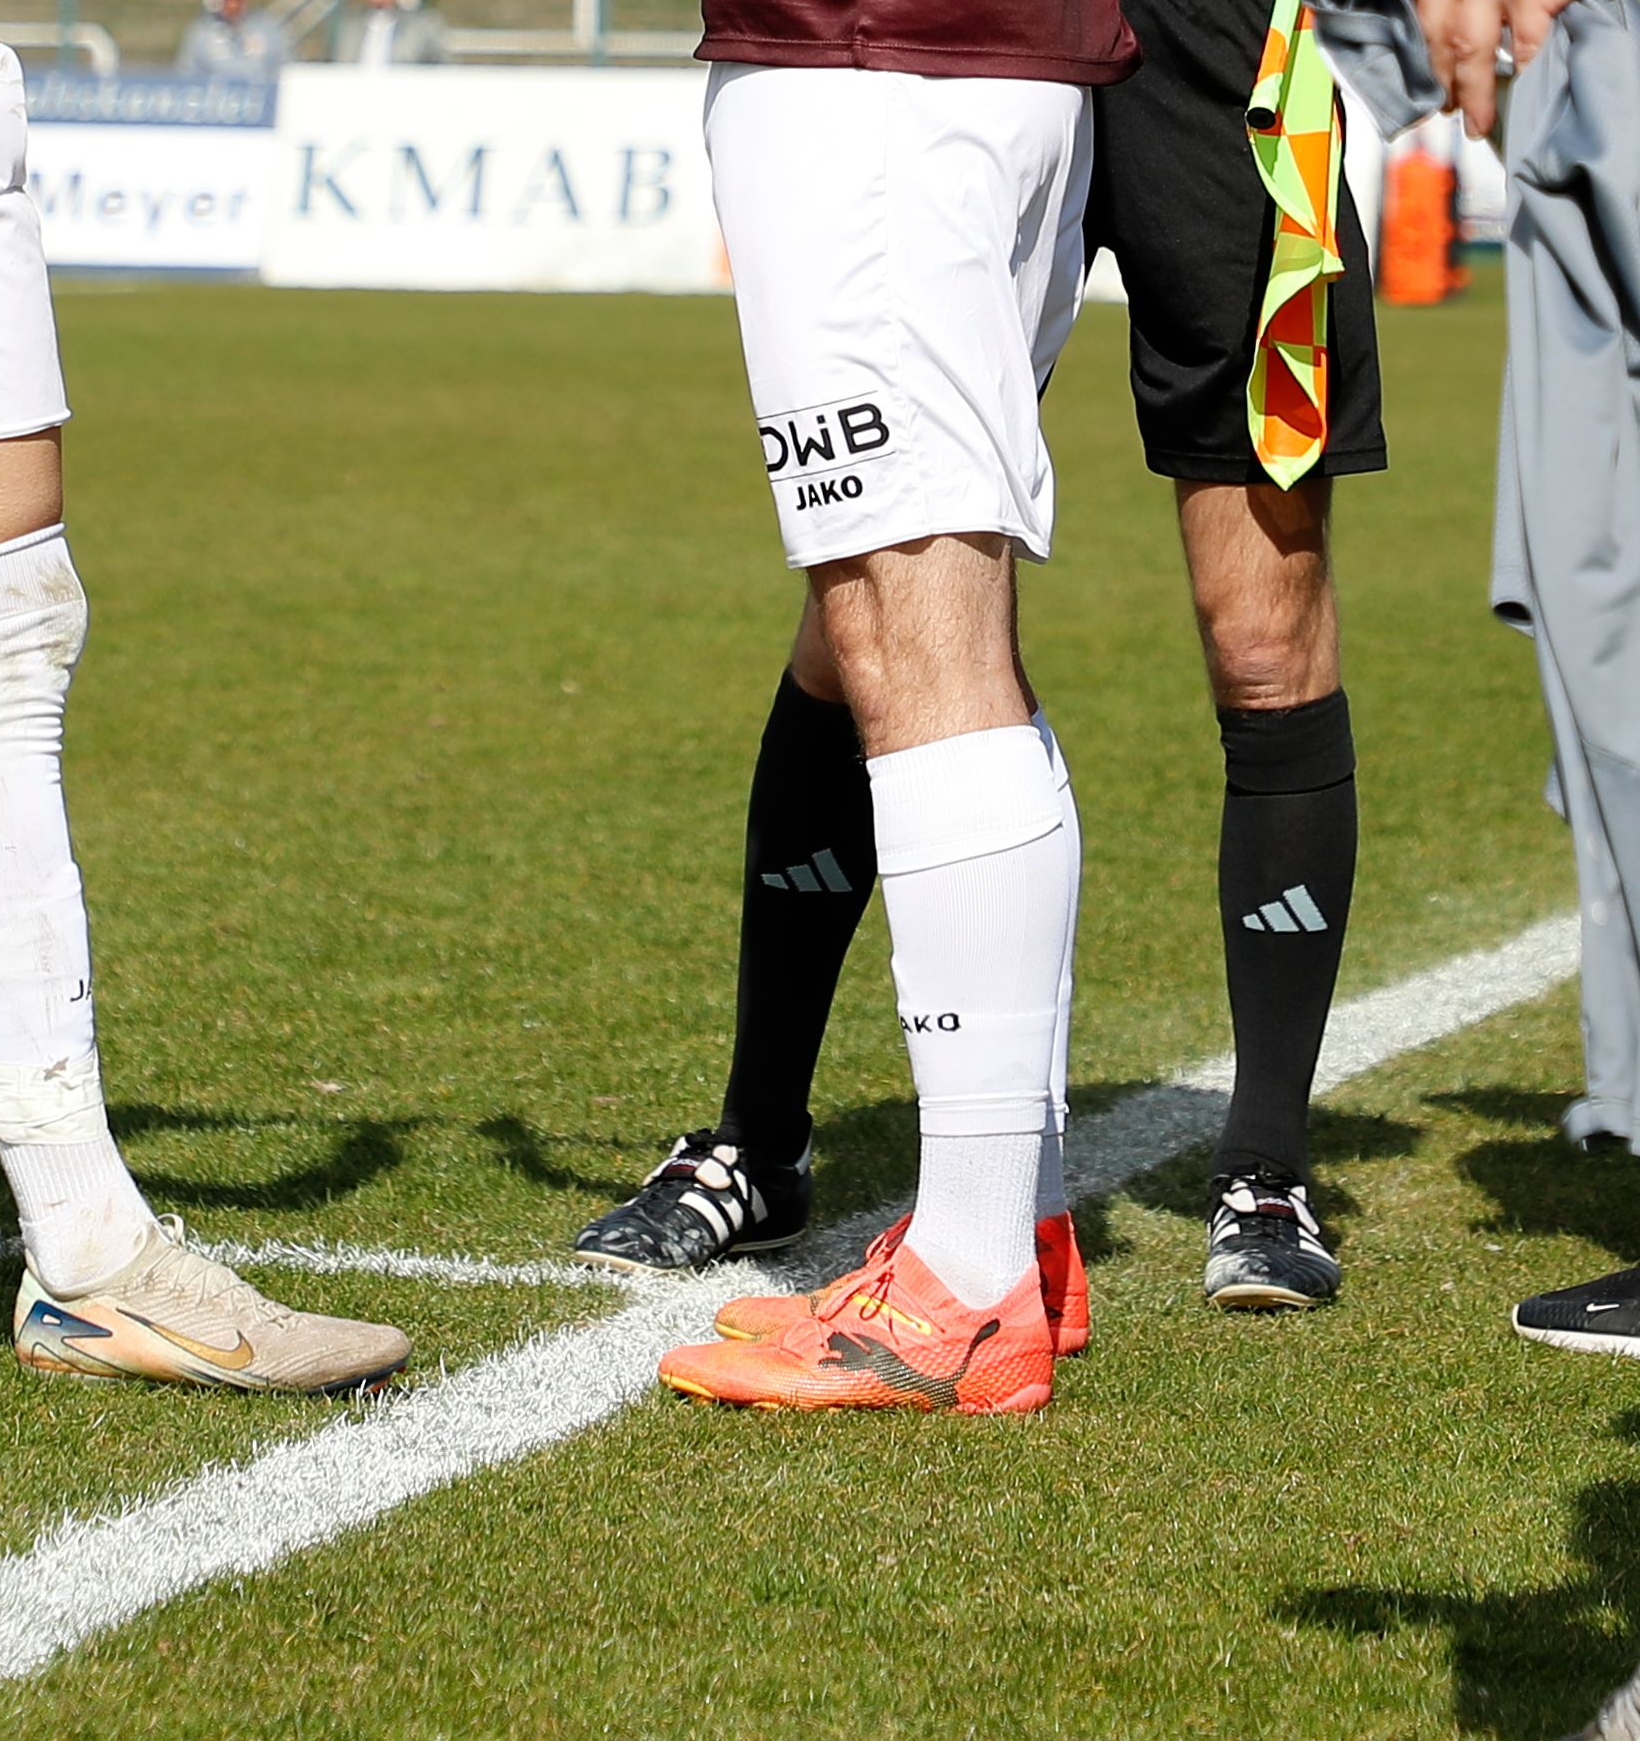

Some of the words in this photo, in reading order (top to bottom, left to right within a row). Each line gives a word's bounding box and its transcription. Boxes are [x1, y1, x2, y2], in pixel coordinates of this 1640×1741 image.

[296, 142, 675, 225] KMAB
[796, 475, 864, 511] JAKO
[899, 1012, 961, 1034] AKO
